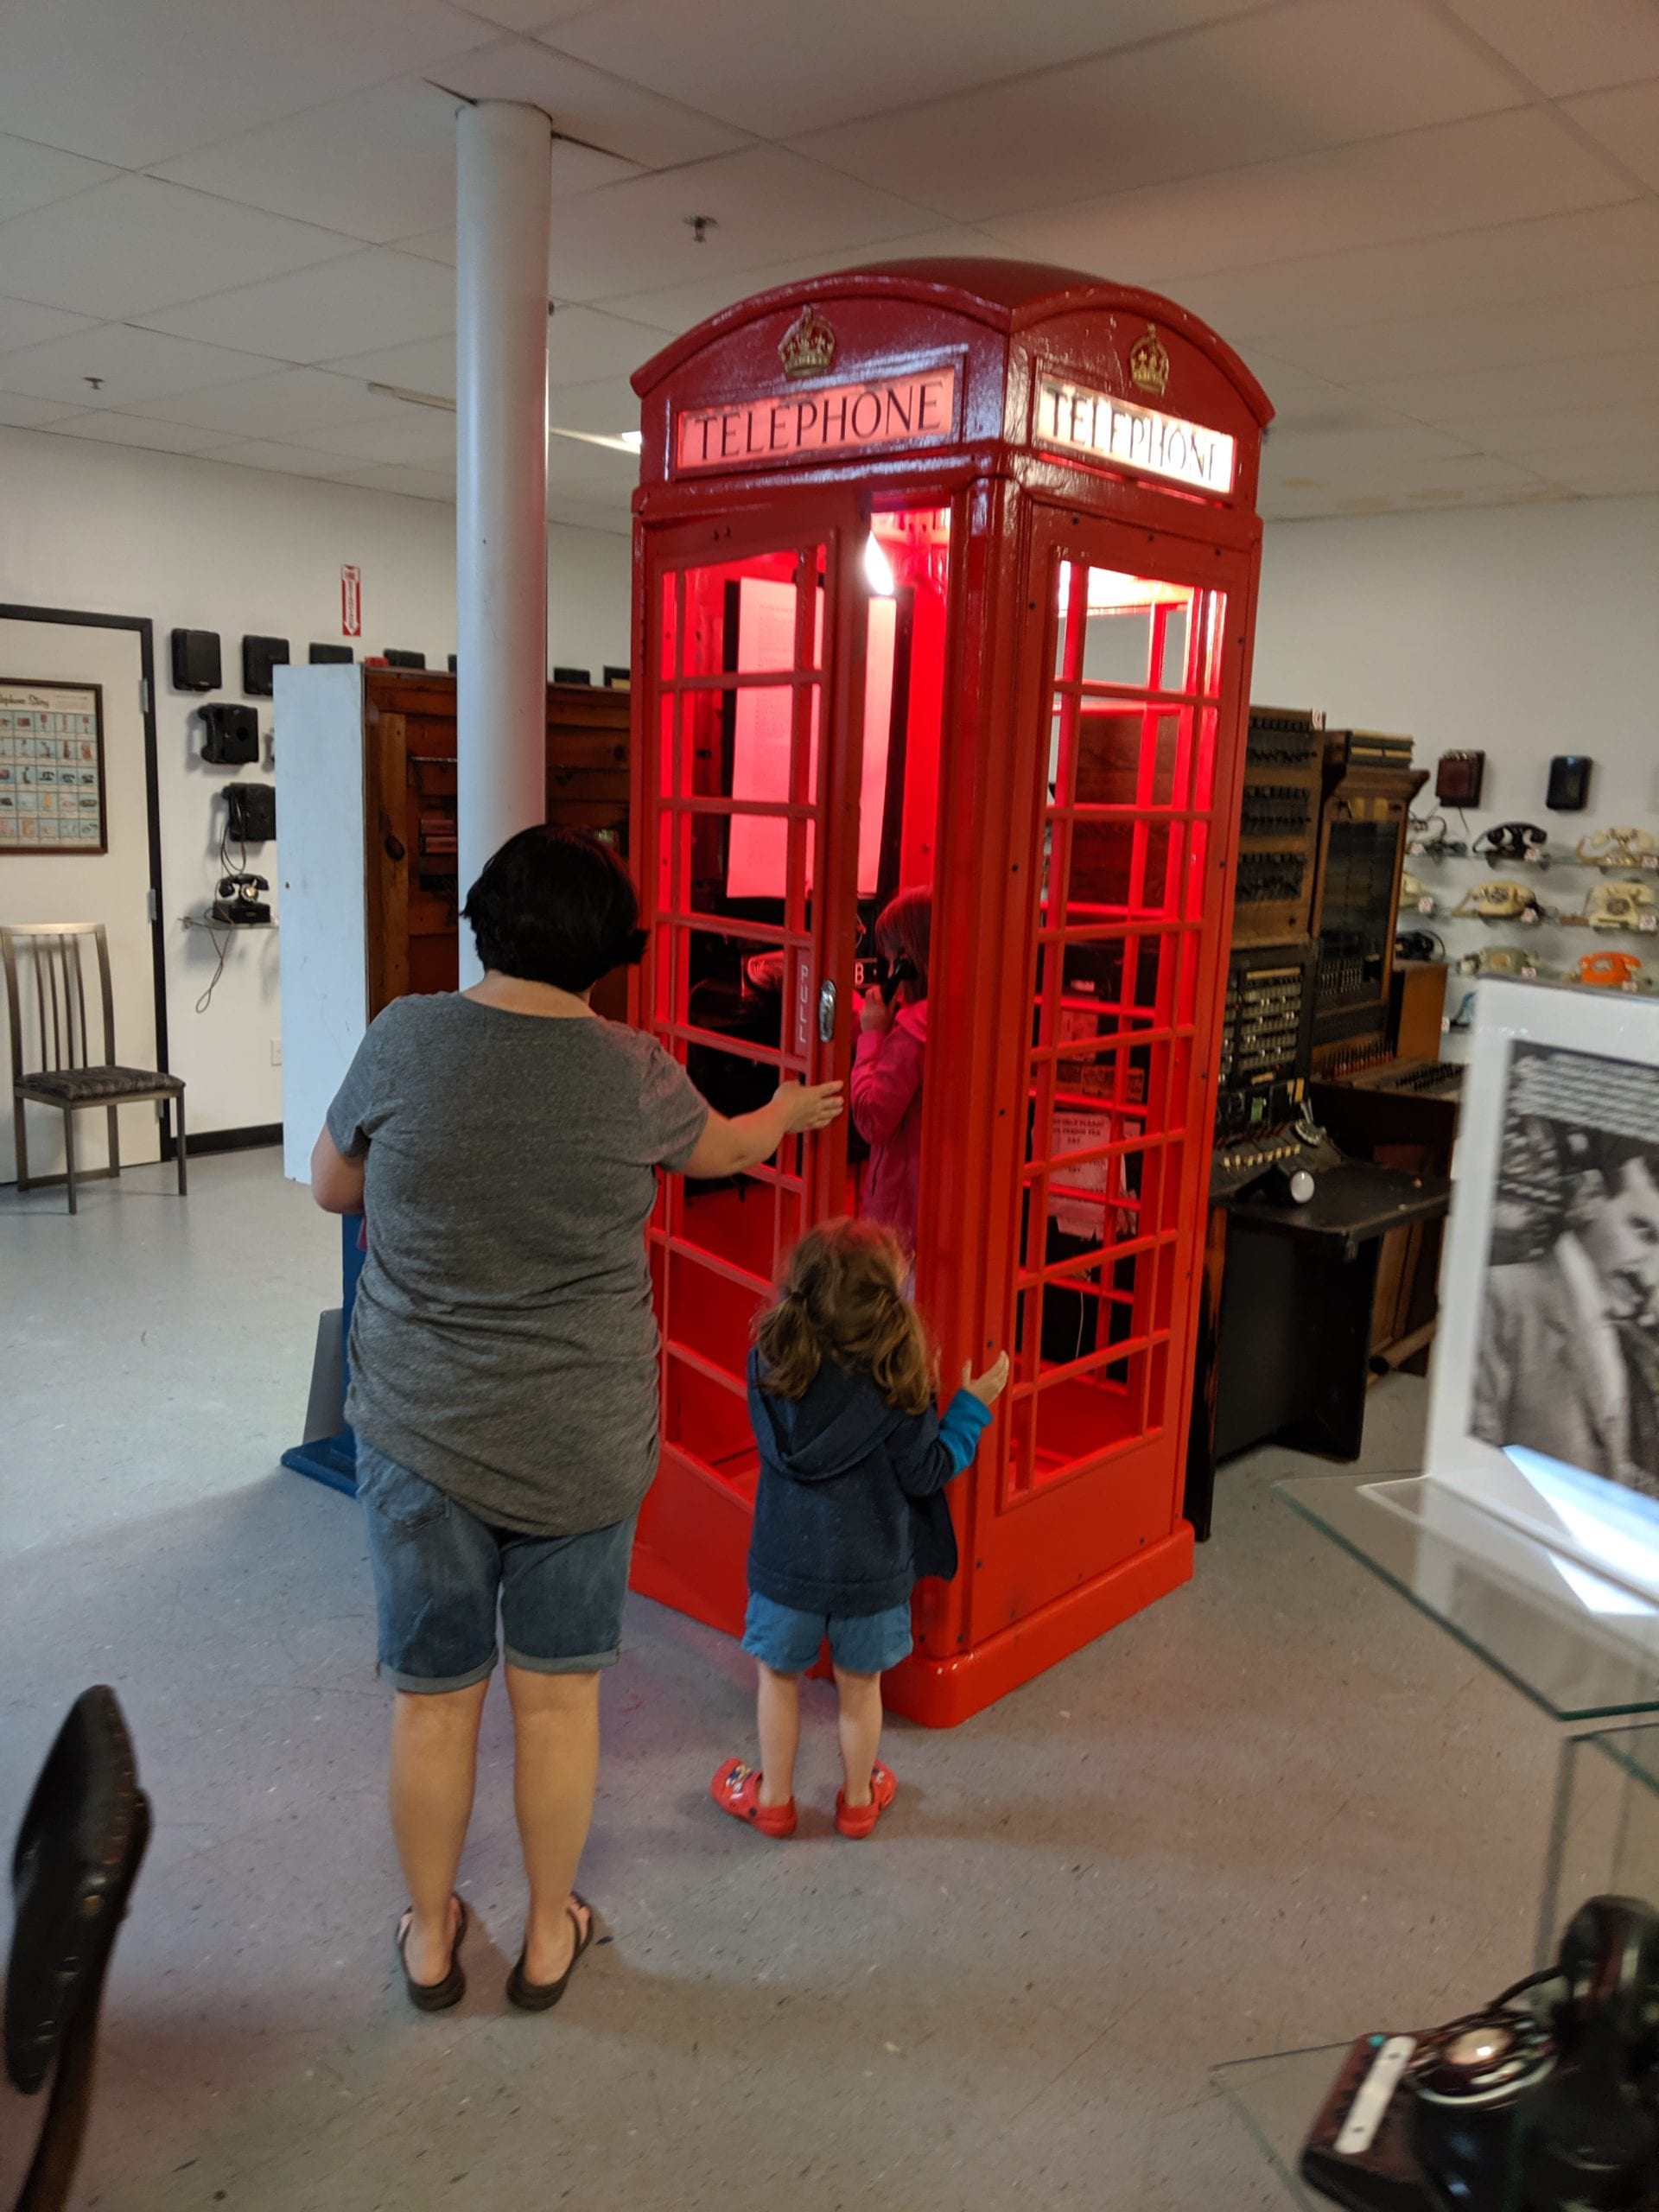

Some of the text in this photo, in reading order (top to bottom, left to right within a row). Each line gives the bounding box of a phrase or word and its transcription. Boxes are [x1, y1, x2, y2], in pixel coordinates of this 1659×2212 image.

[695, 381, 943, 460] TELEPHONE
[799, 964, 809, 1044] PULL
[855, 962, 864, 986] B
